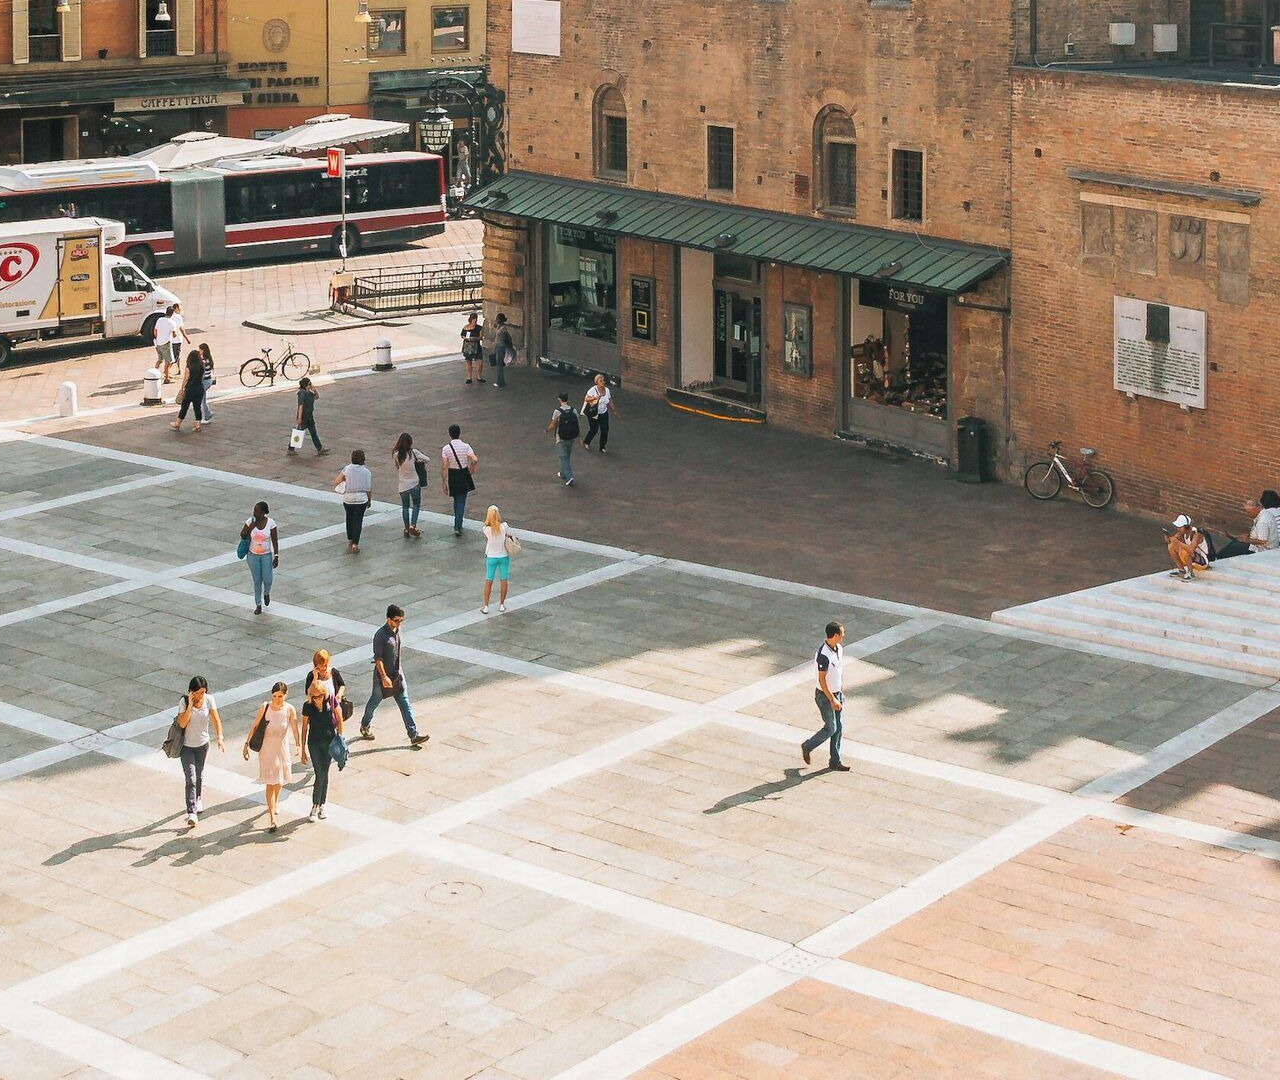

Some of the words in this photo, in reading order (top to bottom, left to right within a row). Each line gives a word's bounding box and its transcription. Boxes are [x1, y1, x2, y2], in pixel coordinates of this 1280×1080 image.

[267, 76, 319, 88] PASCHI
[141, 95, 218, 109] CAFFETTERIA
[128, 295, 144, 303] DAC
[888, 288, 905, 302] FOR
[906, 293, 924, 305] YOU
